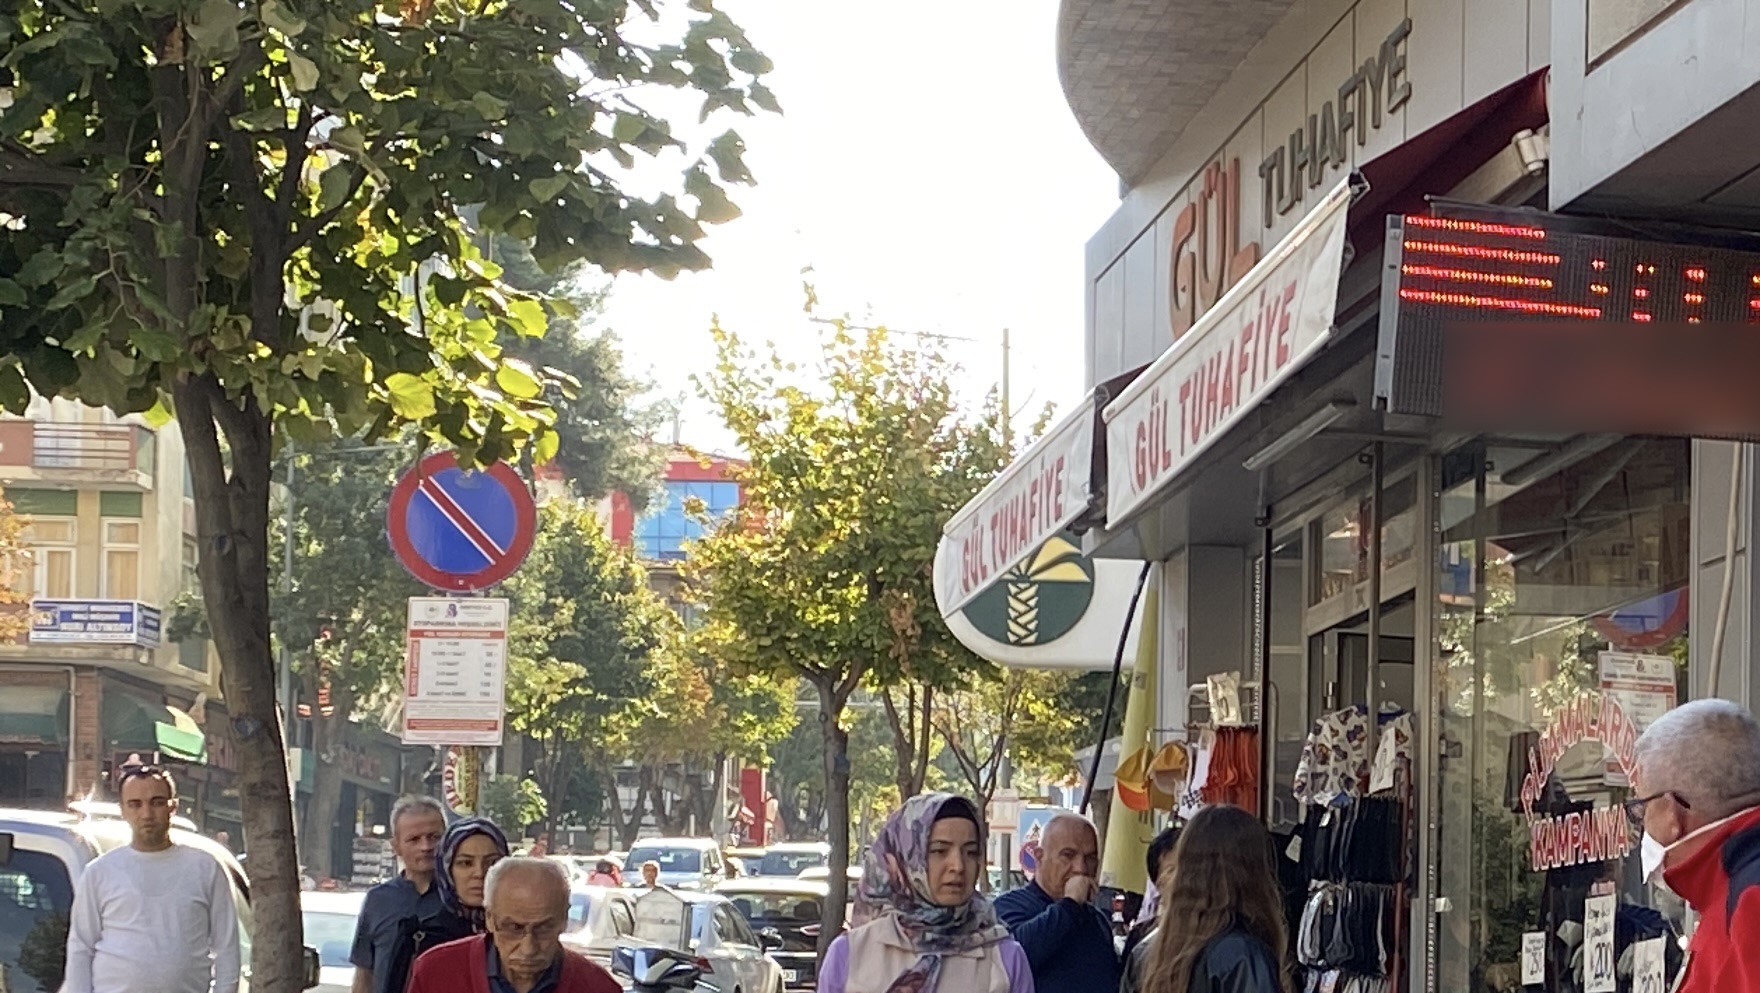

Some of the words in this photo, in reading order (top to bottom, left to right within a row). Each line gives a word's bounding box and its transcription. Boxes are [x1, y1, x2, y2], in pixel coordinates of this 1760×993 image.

[1171, 157, 1261, 340] GÜL
[1136, 386, 1172, 492] GÜL
[1179, 279, 1298, 458] TUHAFİYE
[963, 513, 988, 593] GÜL
[990, 455, 1065, 574] TUHAFİYE
[1531, 802, 1631, 873] KAMPANYA
